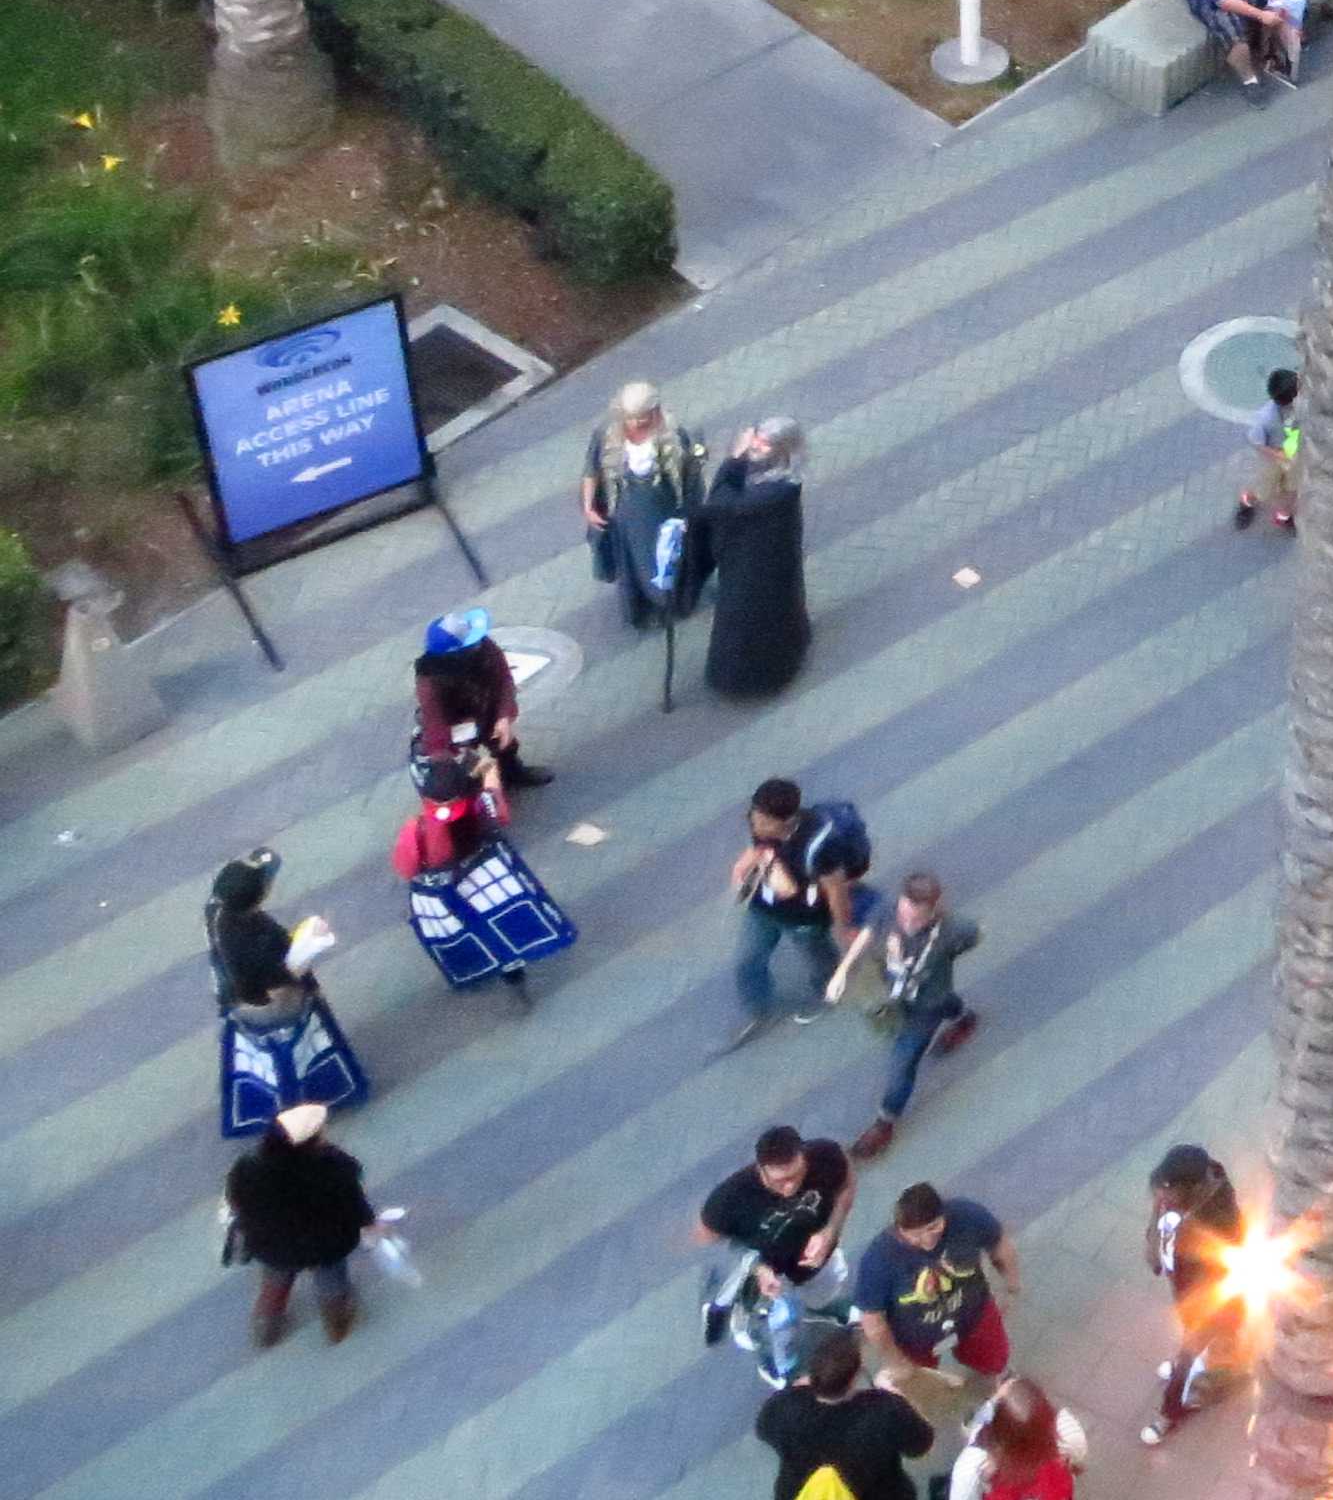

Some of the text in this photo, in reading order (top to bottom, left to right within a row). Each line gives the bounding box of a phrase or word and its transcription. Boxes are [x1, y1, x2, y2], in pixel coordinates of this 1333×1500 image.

[235, 387, 391, 457] ACCESS LINE
[266, 380, 353, 421] ARENA
[256, 414, 375, 467] THIS WAY
